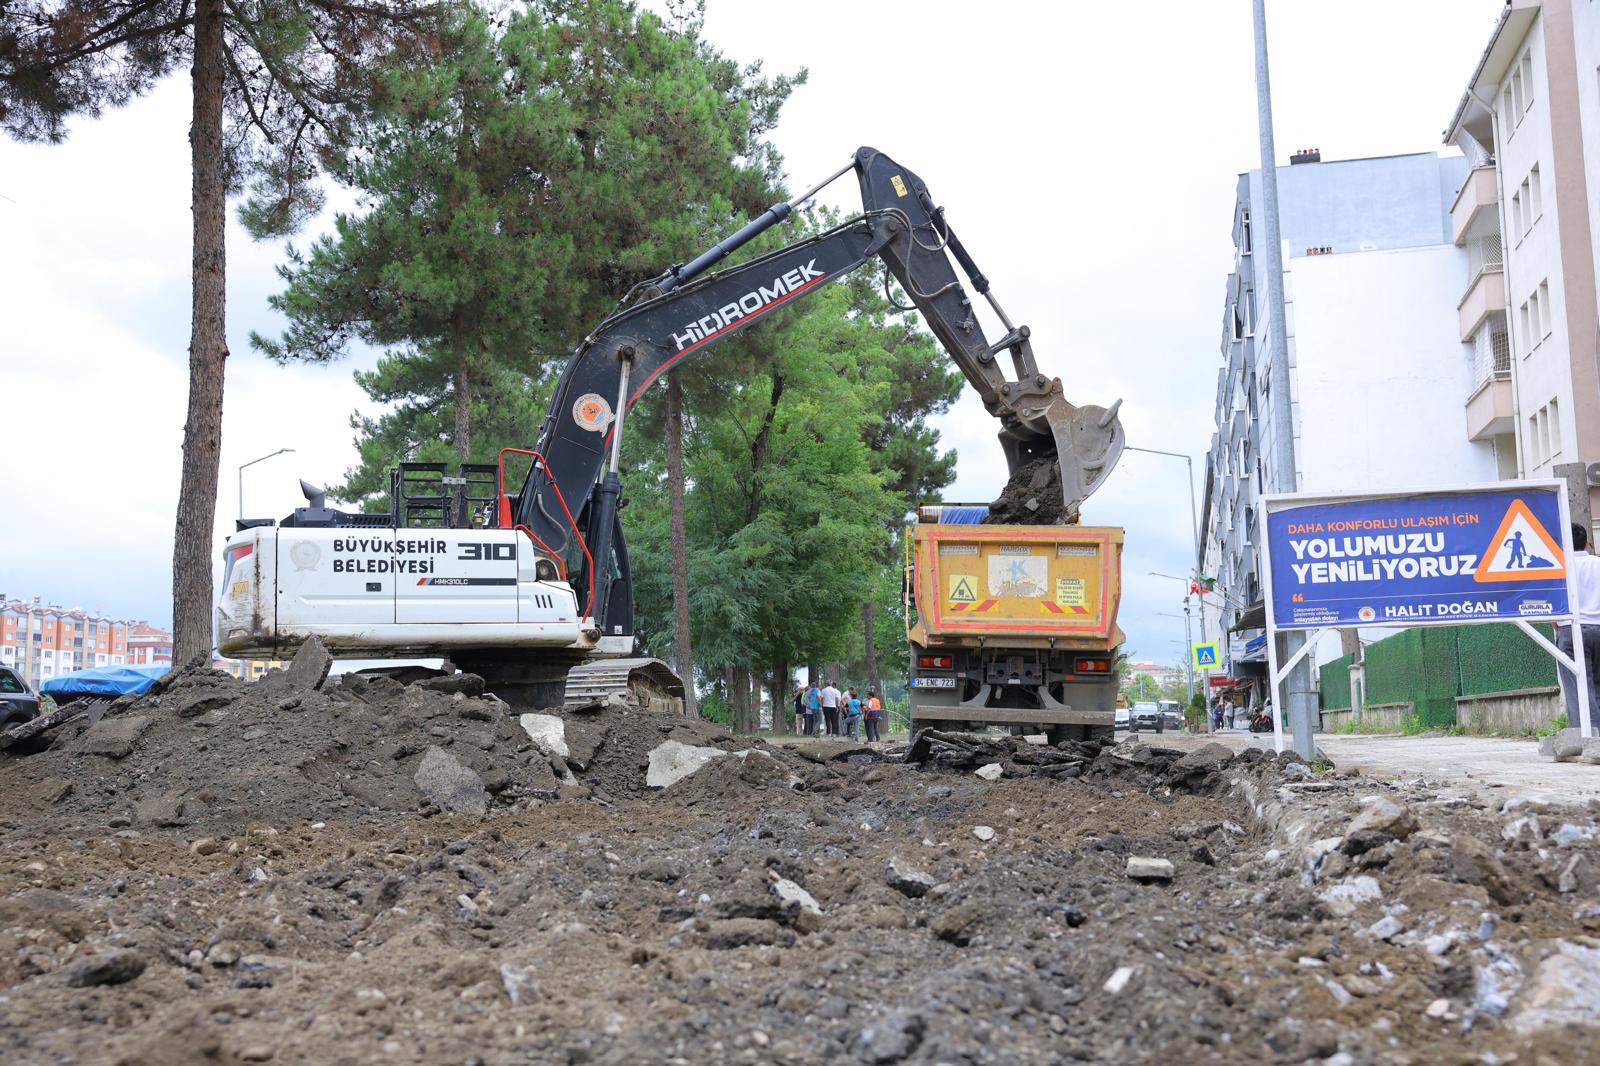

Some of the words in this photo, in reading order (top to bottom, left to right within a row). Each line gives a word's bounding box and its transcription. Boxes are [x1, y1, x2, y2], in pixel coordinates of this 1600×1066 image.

[1288, 523, 1325, 535] DAHA
[1327, 518, 1398, 532] KONFORLU
[1401, 515, 1449, 529] ULAŞIM
[1452, 512, 1480, 526] İÇİN
[333, 536, 447, 555] BÜYÜKŞEHİR
[457, 543, 517, 560] 310
[1289, 532, 1445, 560] YOLUMUZU
[333, 556, 434, 574] BELEDİYESİ
[1437, 600, 1498, 615] DOĞAN
[916, 679, 924, 687] 34
[942, 679, 954, 687] 723
